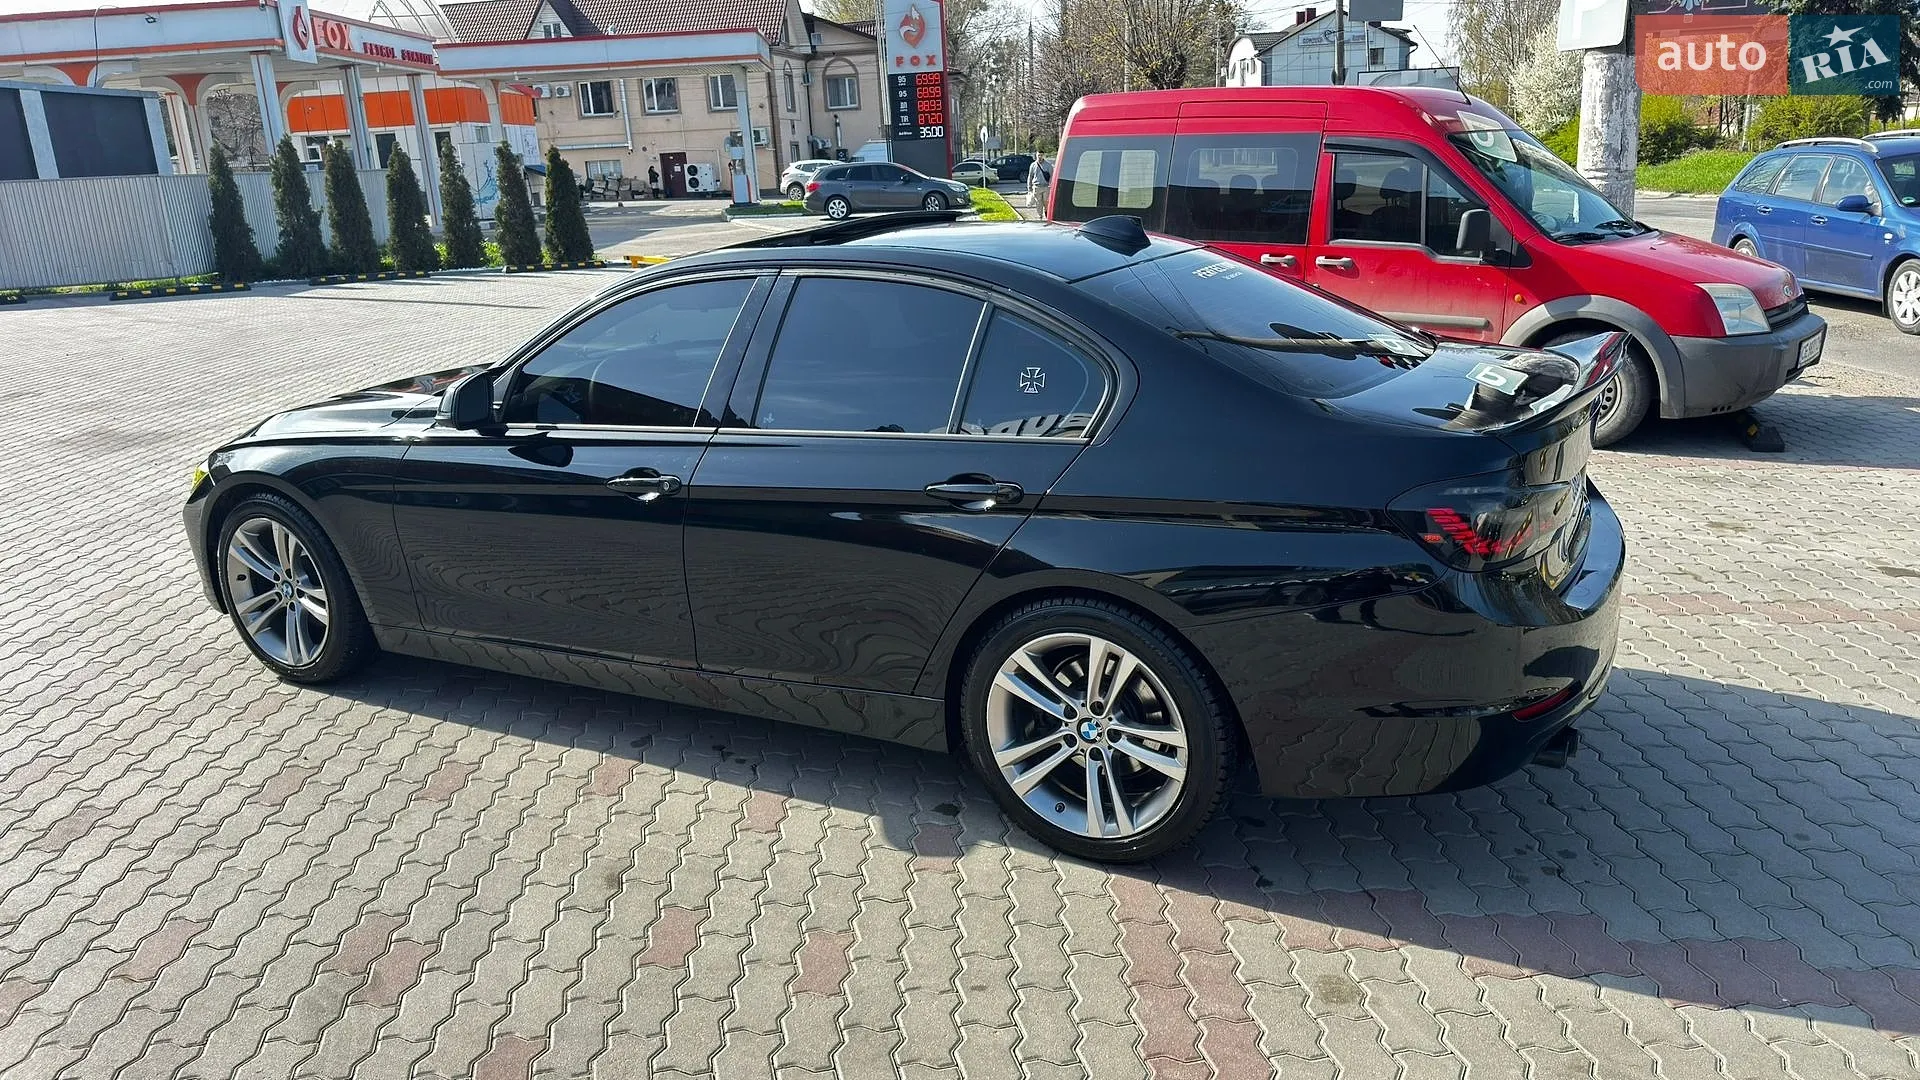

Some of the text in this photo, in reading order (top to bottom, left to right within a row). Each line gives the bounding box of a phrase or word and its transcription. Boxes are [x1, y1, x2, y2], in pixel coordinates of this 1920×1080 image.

[311, 16, 434, 65] FOX PETROL STATION
[895, 55, 936, 67] FOX
